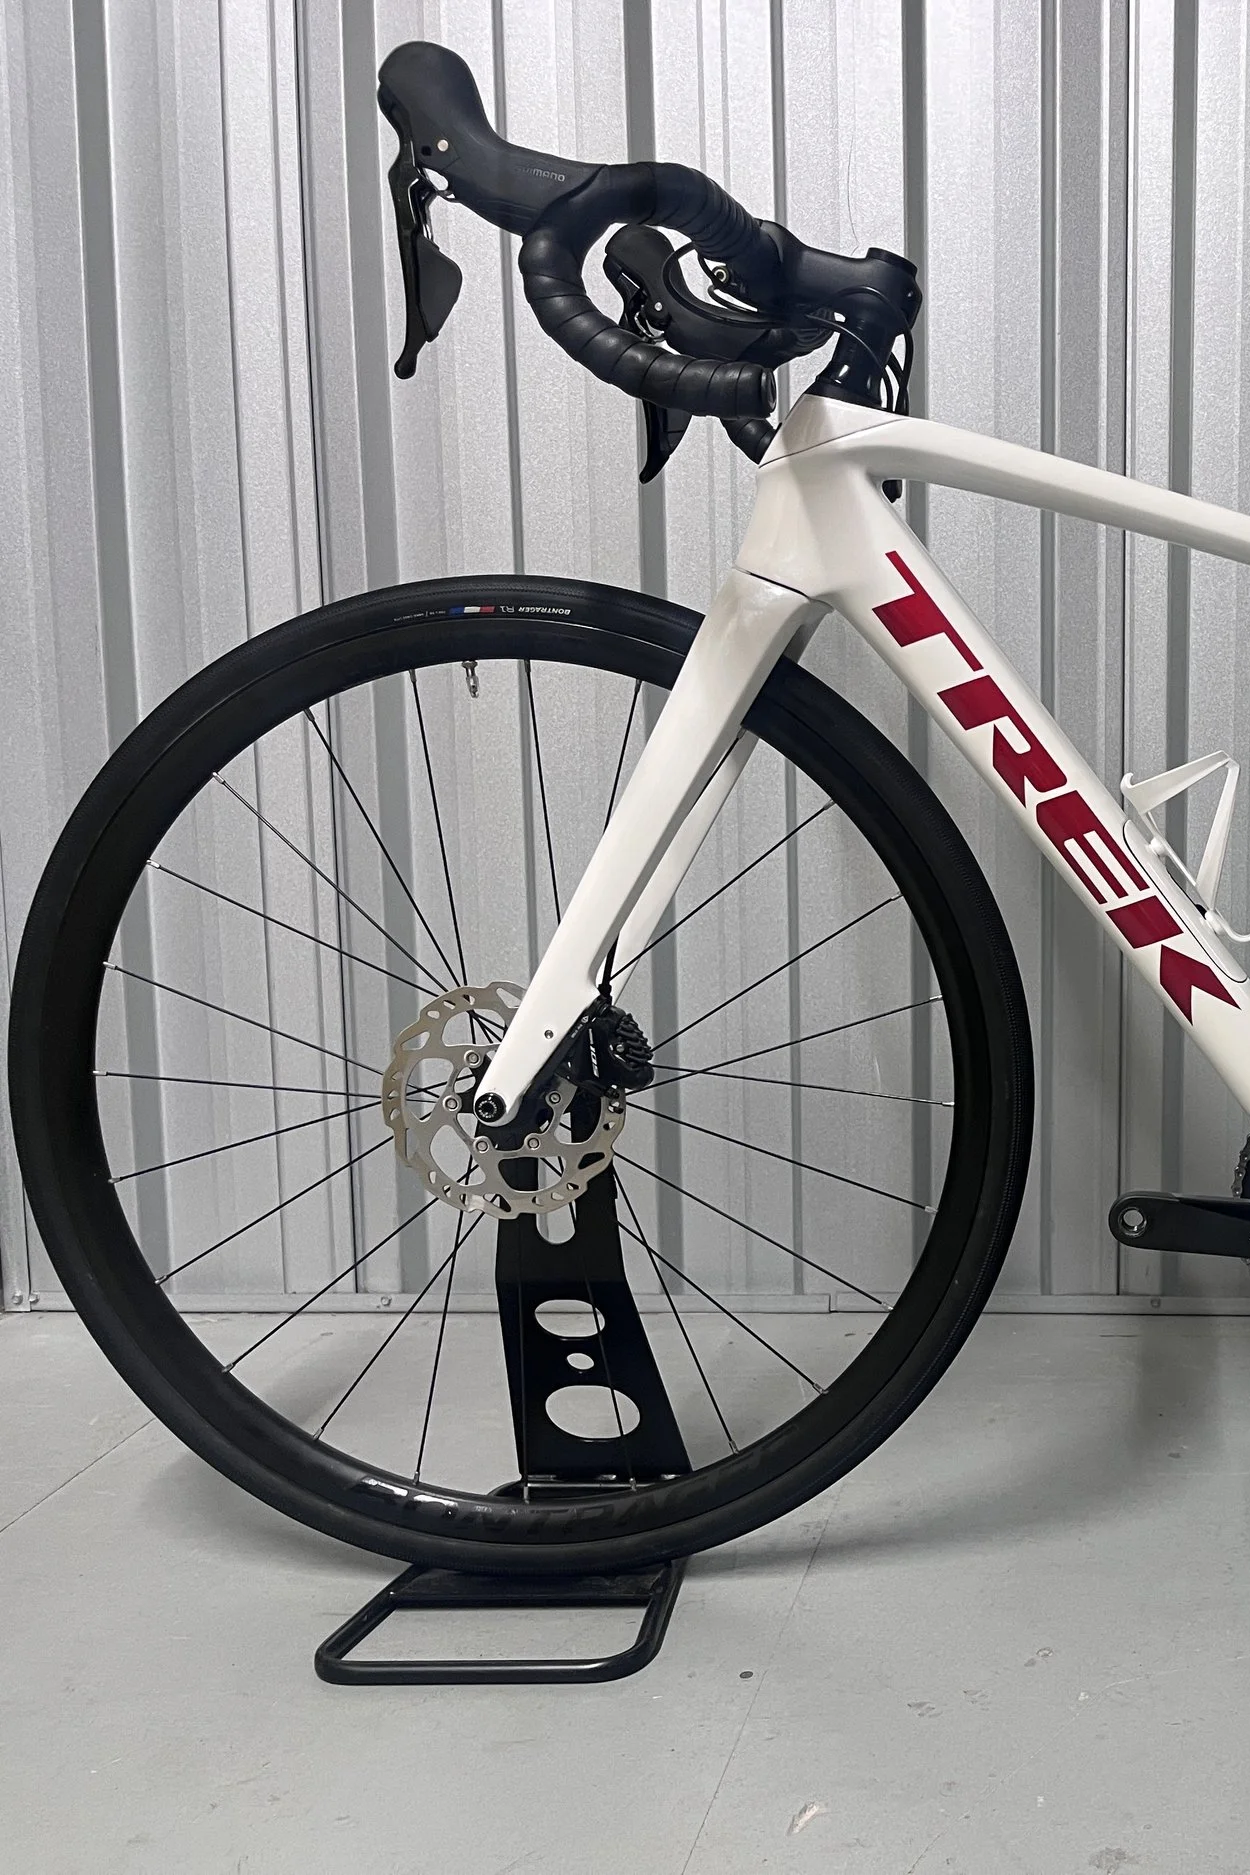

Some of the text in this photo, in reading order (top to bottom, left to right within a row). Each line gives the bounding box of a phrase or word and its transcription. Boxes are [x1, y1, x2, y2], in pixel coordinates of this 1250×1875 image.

[500, 605, 572, 616] BONTRAGER R1
[872, 550, 1242, 1026] TREK
